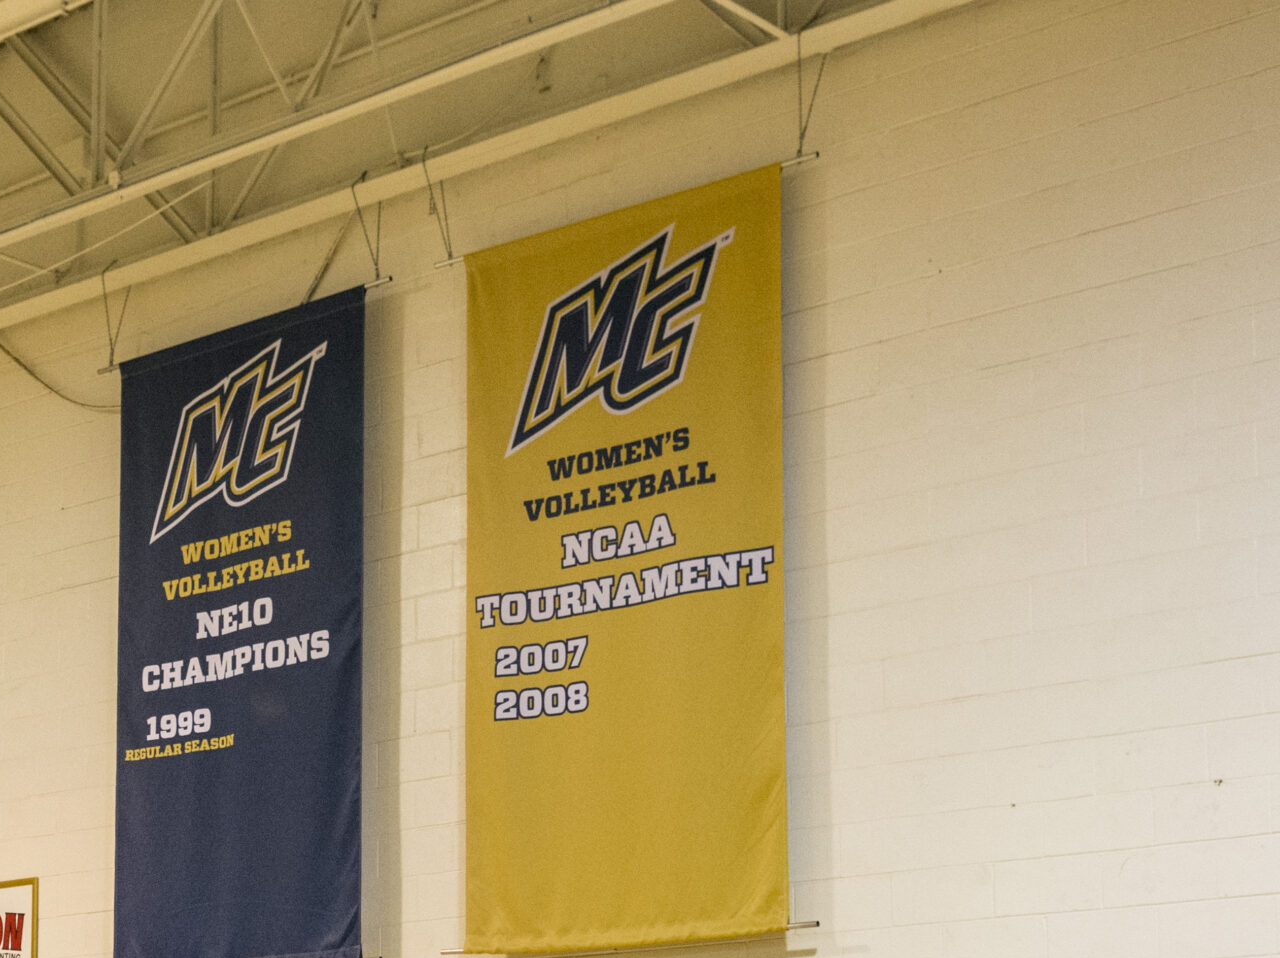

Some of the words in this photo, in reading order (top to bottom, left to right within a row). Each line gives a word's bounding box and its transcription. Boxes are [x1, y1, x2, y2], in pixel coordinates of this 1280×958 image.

[547, 427, 691, 482] WOMEN'S
[523, 460, 716, 522] VOLLEYBALL
[180, 519, 293, 566] WOMEN'S
[561, 513, 676, 569] NCAA
[162, 549, 310, 601] VOLLEYBALL
[475, 546, 774, 629] TOURNAMENT
[195, 597, 274, 640] NE10
[141, 629, 330, 693] CHAMPIONS
[494, 636, 589, 677] 2007
[146, 707, 212, 742] 1999
[493, 681, 589, 721] 2008
[124, 741, 182, 762] REGULAR
[184, 734, 235, 755] SEASON
